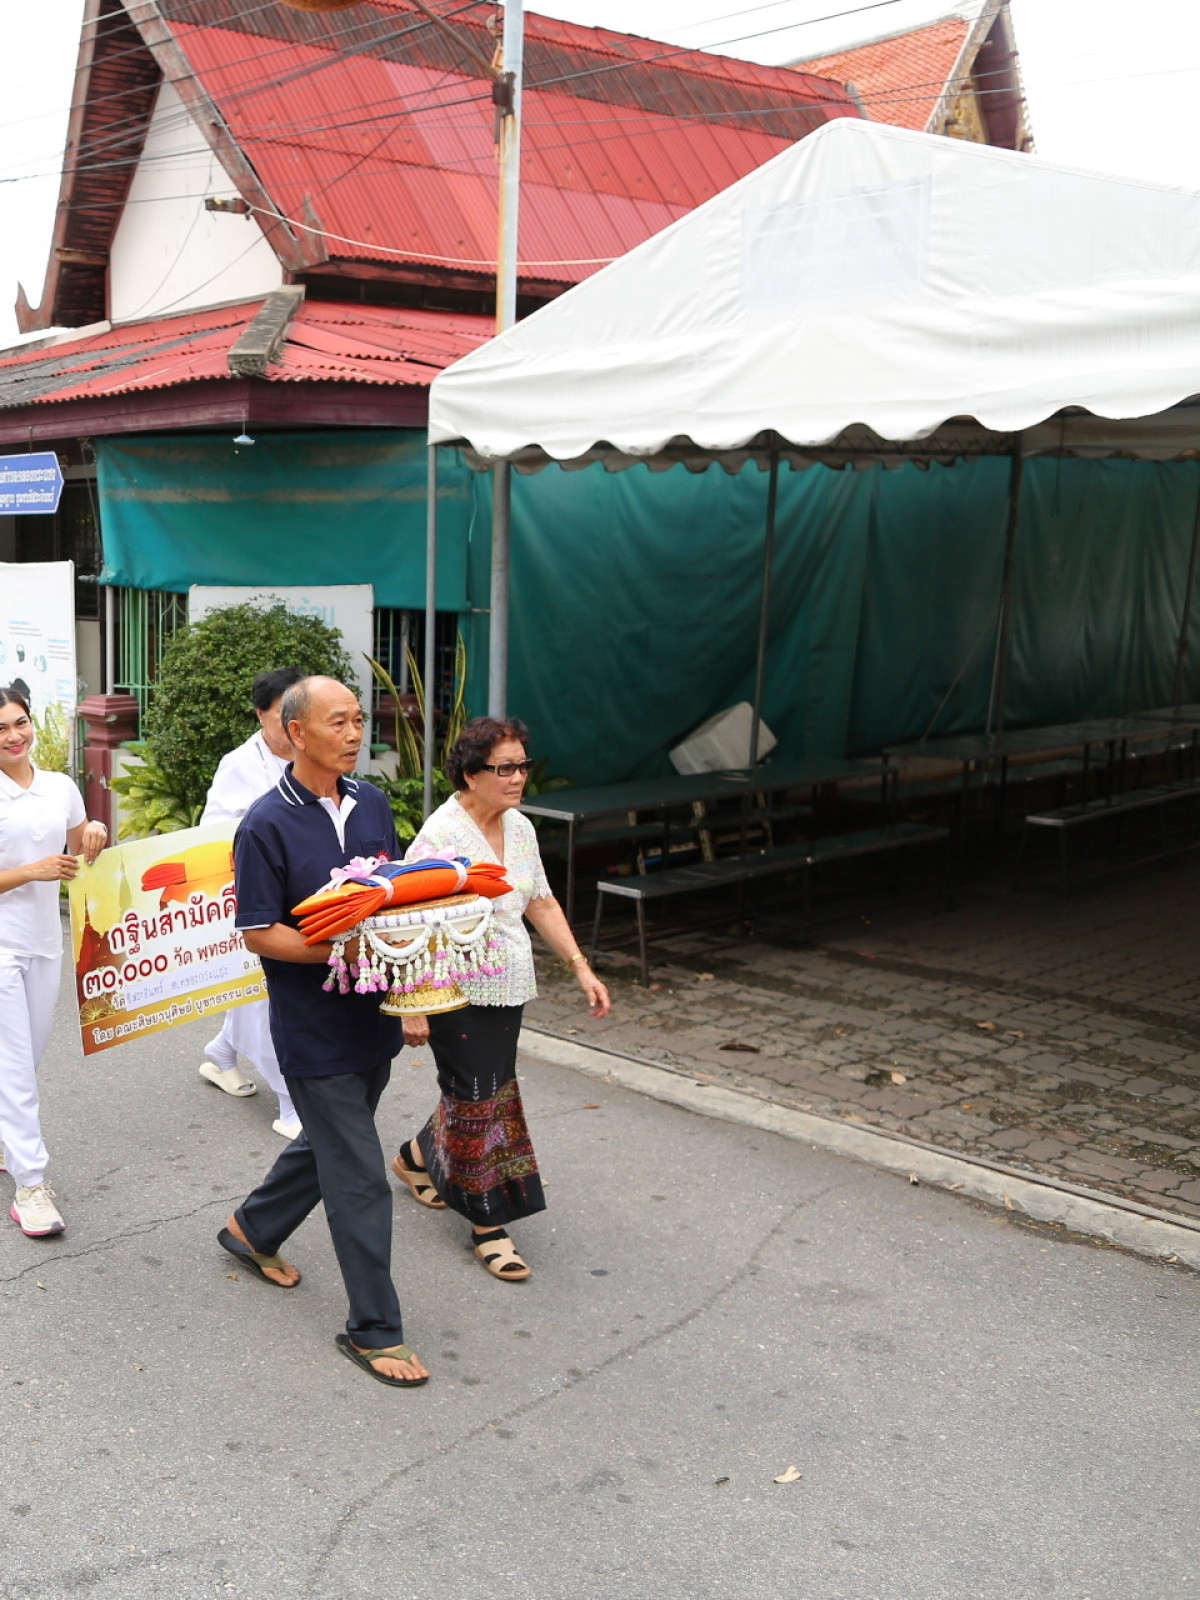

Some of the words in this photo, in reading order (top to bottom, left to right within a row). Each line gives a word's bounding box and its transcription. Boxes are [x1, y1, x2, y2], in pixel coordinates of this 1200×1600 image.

[111, 885, 238, 954] กฐินสามัคคี
[86, 954, 168, 994] ๓๐,๐๐๐
[174, 947, 193, 966] วัด
[196, 932, 246, 962] พุทธศัก
[93, 1028, 114, 1044] โดย
[195, 988, 242, 1015] บูชาธรรม
